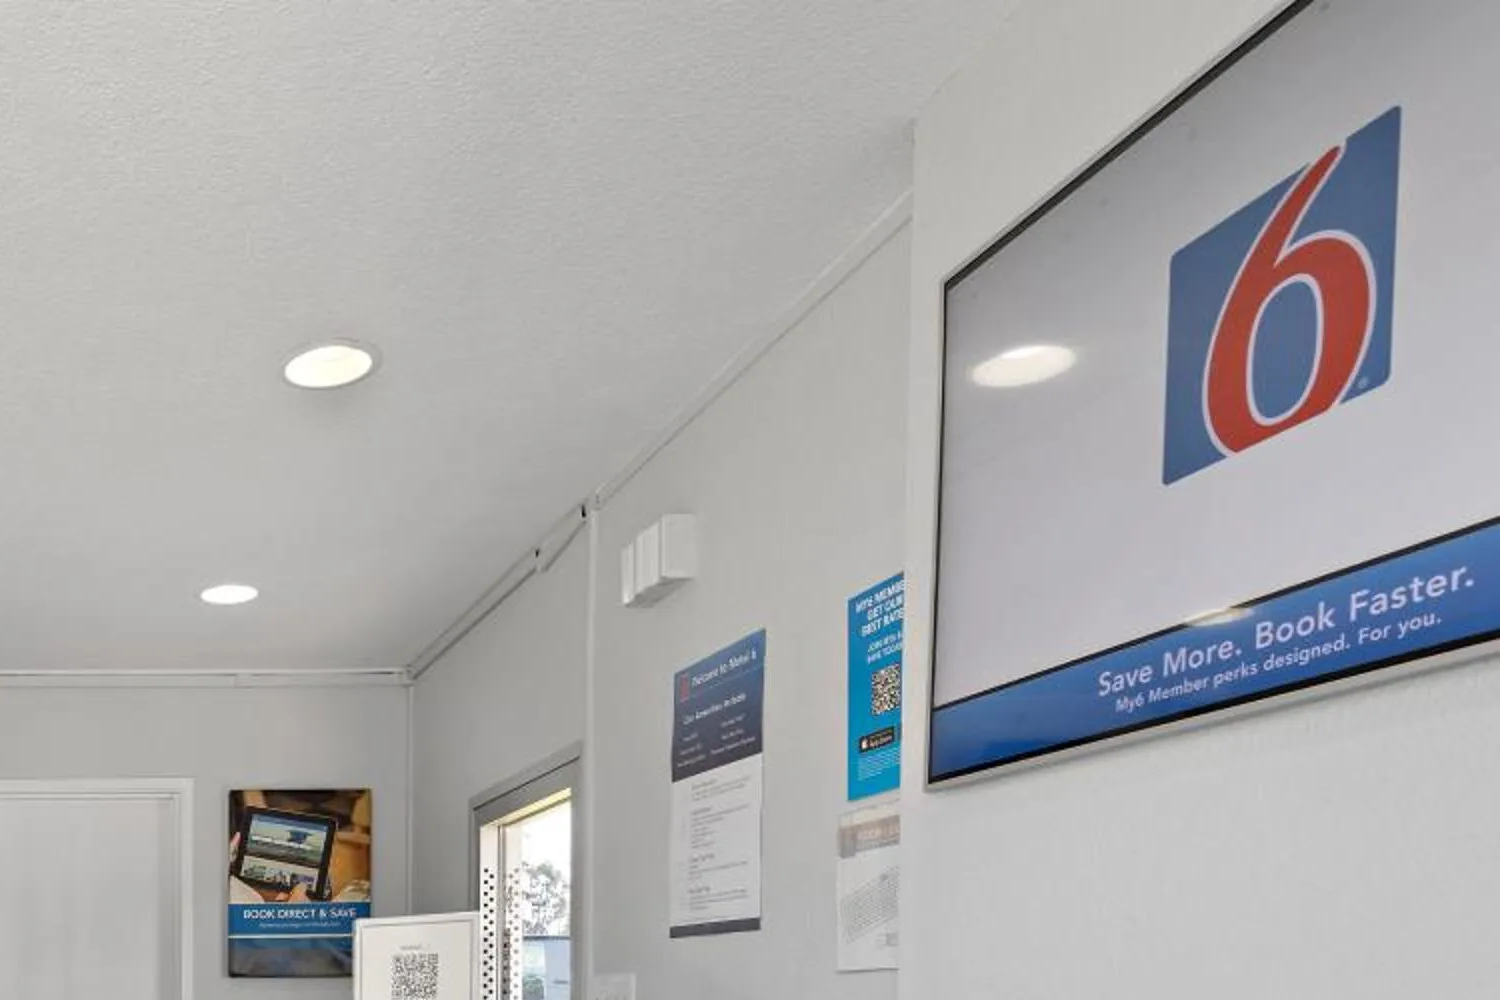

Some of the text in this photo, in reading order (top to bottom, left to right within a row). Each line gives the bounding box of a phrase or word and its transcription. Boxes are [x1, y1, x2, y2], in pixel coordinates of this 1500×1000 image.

[1202, 145, 1377, 457] 6
[1098, 566, 1475, 697] Save More. Book Faster.
[1116, 613, 1442, 714] My6 Member perks designed. For you.
[243, 908, 275, 920] BOOK
[277, 908, 316, 920] DIRECT
[330, 907, 357, 919] SAVE
